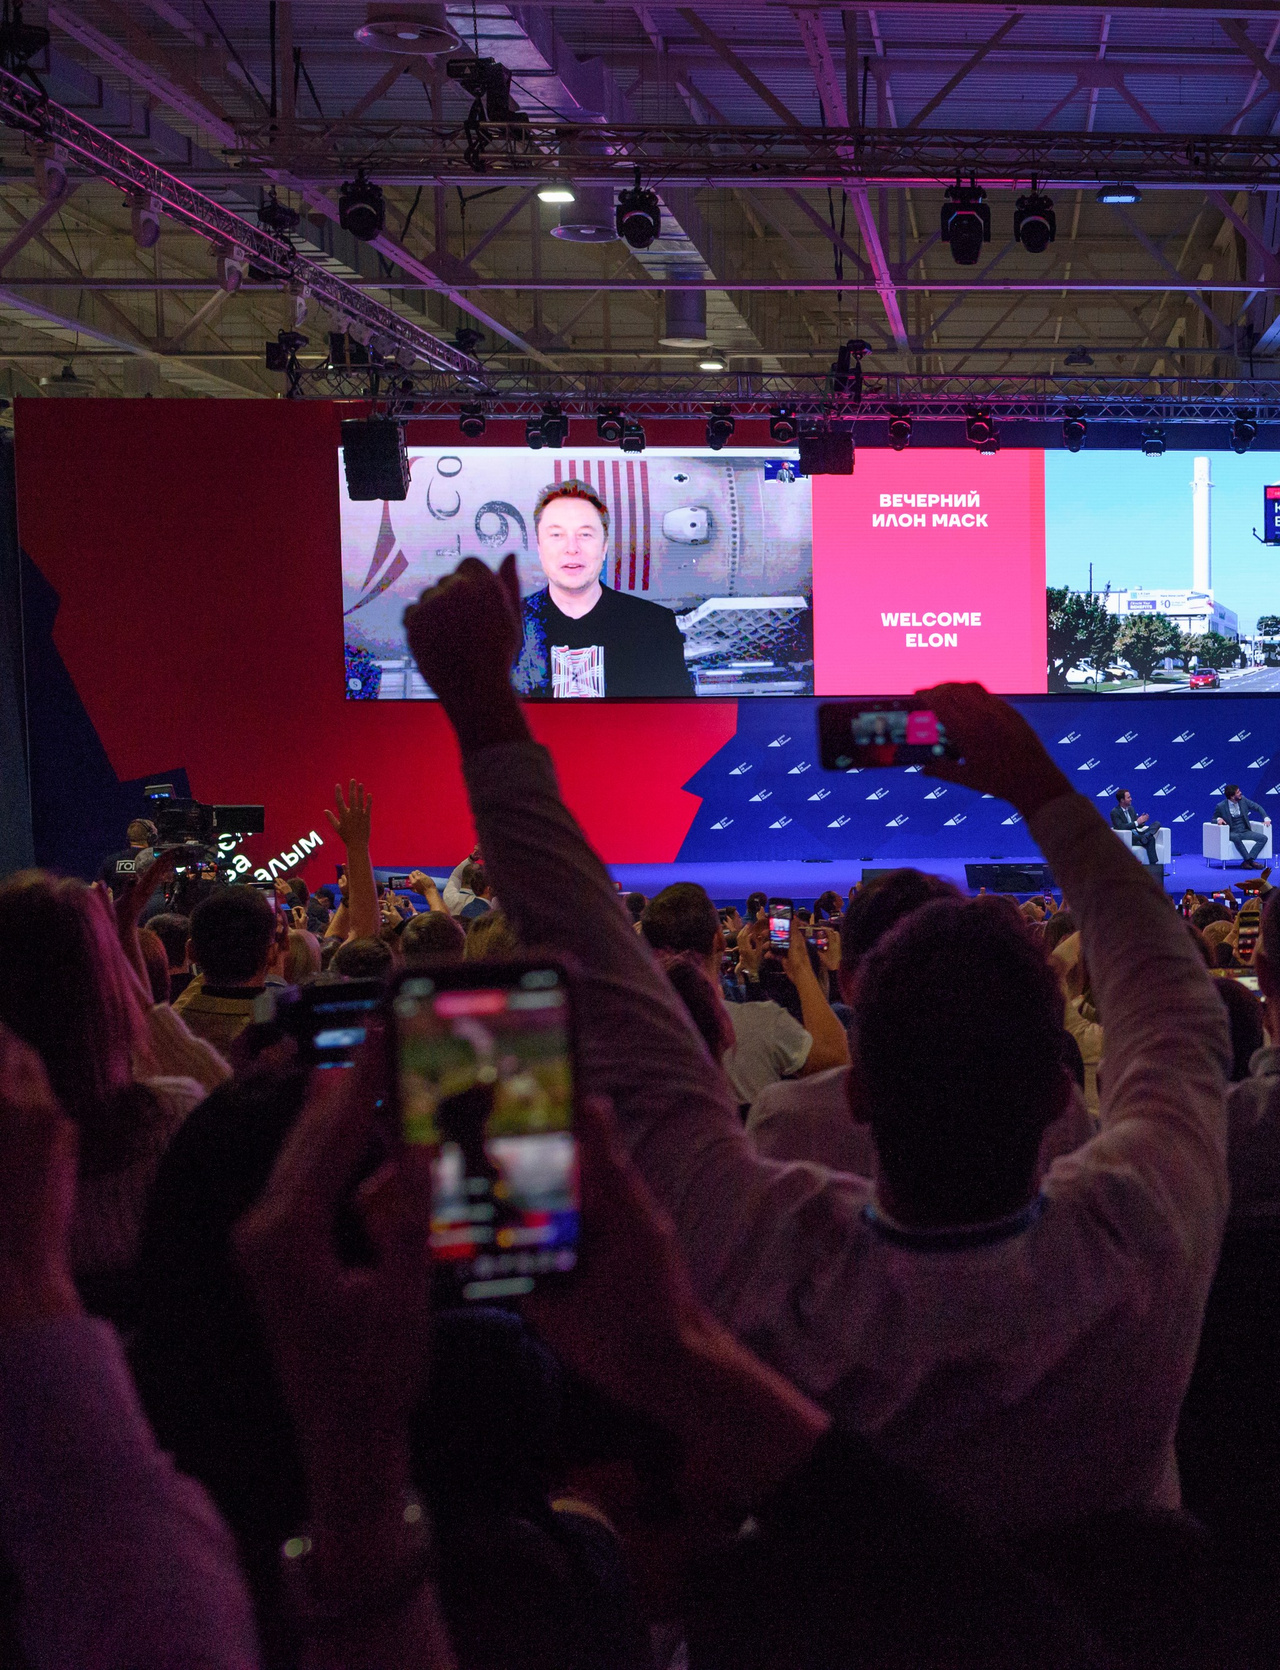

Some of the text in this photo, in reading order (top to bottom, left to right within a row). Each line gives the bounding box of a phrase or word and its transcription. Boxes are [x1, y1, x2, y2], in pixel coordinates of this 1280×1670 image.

[879, 490, 980, 508] ВЕЧЕРНИЙ
[872, 513, 989, 528] ИЛОН МАСК
[881, 611, 982, 627] WELCOME
[905, 633, 958, 648] ELON
[254, 830, 324, 881] алым
